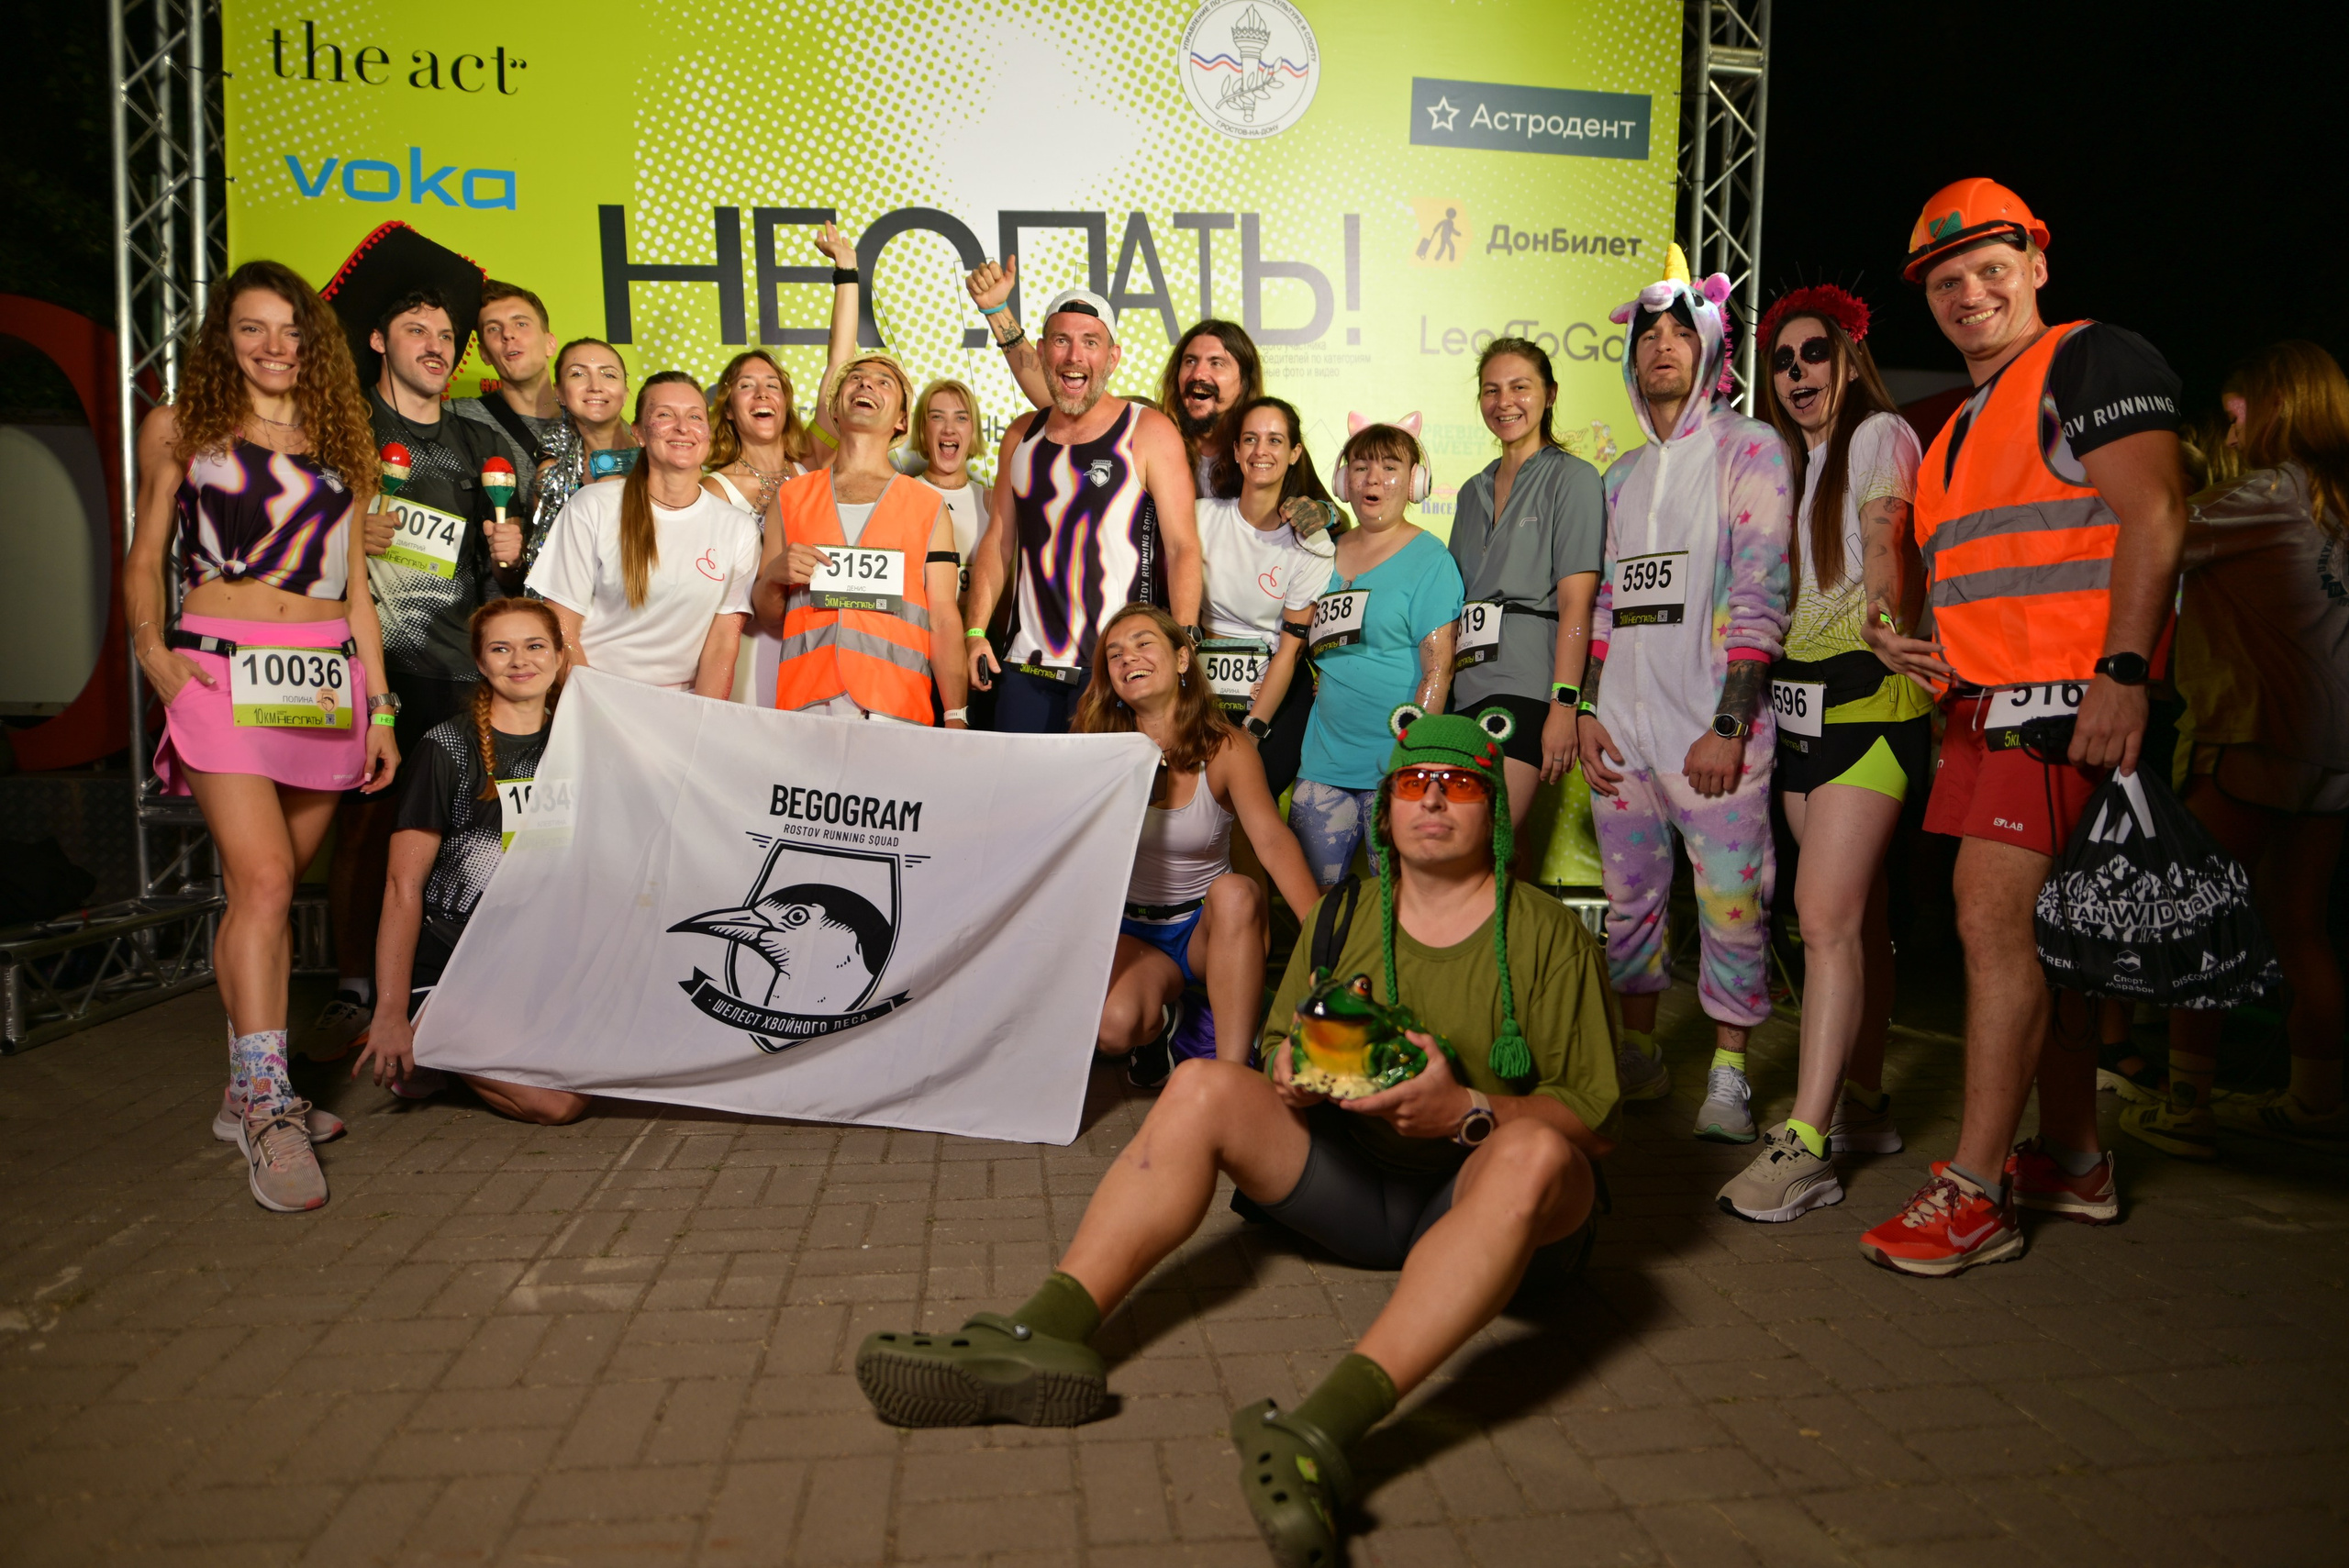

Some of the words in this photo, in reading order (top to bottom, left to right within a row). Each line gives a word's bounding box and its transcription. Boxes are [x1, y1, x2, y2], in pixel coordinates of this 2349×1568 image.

[266, 19, 390, 85] the
[1303, 30, 1317, 62] СПОРТУ
[1469, 103, 1636, 139] Астродент
[284, 147, 517, 210] voka
[1486, 224, 1642, 256] ДонБилет
[1259, 351, 1309, 364] обедителей
[2093, 395, 2176, 428] RUNNING
[392, 505, 456, 546] 0074
[827, 551, 888, 580] 5152
[1141, 534, 1150, 578] RUNNING
[1622, 560, 1672, 593] 5595
[1314, 595, 1353, 628] 5358
[1458, 606, 1486, 637] 19
[242, 653, 342, 689] 10036
[1207, 657, 1258, 683] 5085
[283, 695, 314, 704] ПОЛИНА
[1773, 684, 1807, 717] 596
[2010, 684, 2084, 707] 516
[769, 784, 923, 832] BEGOGRAM
[784, 823, 820, 838] ROSTOV
[823, 828, 865, 844] RUNNING
[868, 834, 899, 847] SQUAD
[712, 998, 763, 1027] ШЕЛЕСТ
[761, 1017, 828, 1034] ХВОЙНОГО
[832, 1014, 868, 1030] ЛЕСА
